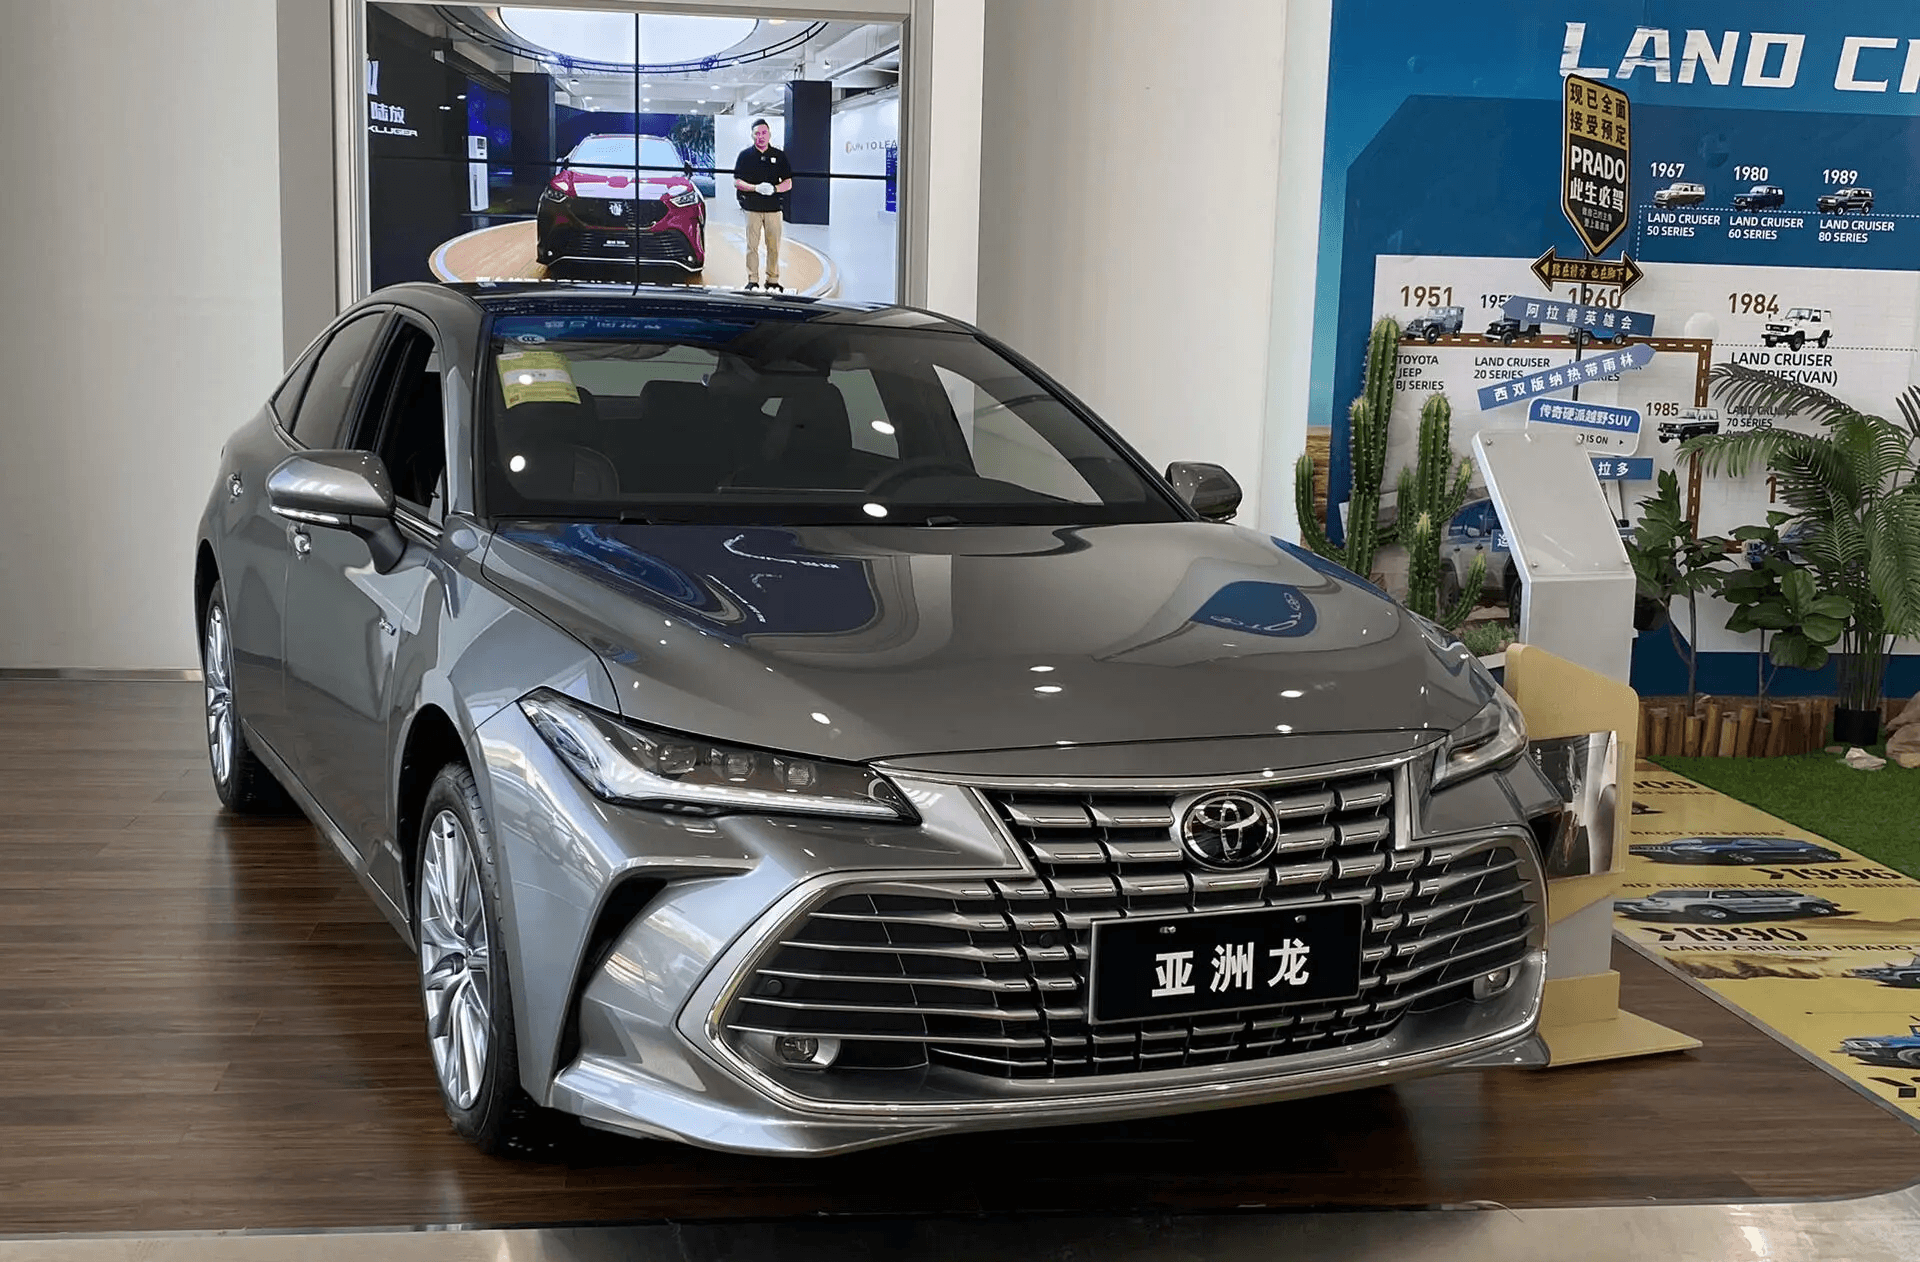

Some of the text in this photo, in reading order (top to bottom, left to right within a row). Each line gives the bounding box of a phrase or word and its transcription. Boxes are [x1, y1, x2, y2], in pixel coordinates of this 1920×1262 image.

[1559, 21, 1806, 89] LAND
[1569, 82, 1626, 121] 现已全面
[1569, 109, 1627, 147] 接受预定
[1571, 145, 1626, 184] PRADO
[1650, 162, 1685, 179] 1967
[1733, 165, 1769, 182] 1980
[1822, 169, 1858, 186] 1989
[1569, 177, 1624, 213] 此生必驾
[1647, 212, 1721, 226] LAND CRUISER
[1729, 215, 1804, 229] LAND CRUISER
[1820, 219, 1895, 233] LAND CRUISER
[1647, 225, 1695, 237] 50 SERIES
[1728, 228, 1777, 240] 60 SERIES
[1818, 231, 1868, 244] 80 SERIES
[1400, 285, 1453, 307] 1951
[1480, 294, 1514, 309] 195
[1568, 287, 1622, 309] 1960
[1728, 293, 1780, 315] 1984
[1525, 302, 1633, 330] 阿拉善英雄会
[1397, 355, 1439, 365] TOYOTA
[1475, 356, 1550, 367] LAND CRUISER
[1731, 352, 1833, 367] LAND CRUISER
[1398, 367, 1422, 379] JEEP
[1473, 369, 1524, 379] 20 SERIES
[1493, 351, 1634, 402] 西双版纳热带雨林
[1396, 380, 1444, 391] BJ SERIES
[1539, 403, 1632, 427] 传奇硬派越野SUV
[1646, 402, 1679, 416] 1985
[1726, 418, 1773, 427] 70 SERIES
[1598, 461, 1629, 476] 拉多
[1780, 868, 1902, 880] 1996
[1674, 927, 1808, 942] 1990
[1151, 937, 1311, 998] 亚洲龙
